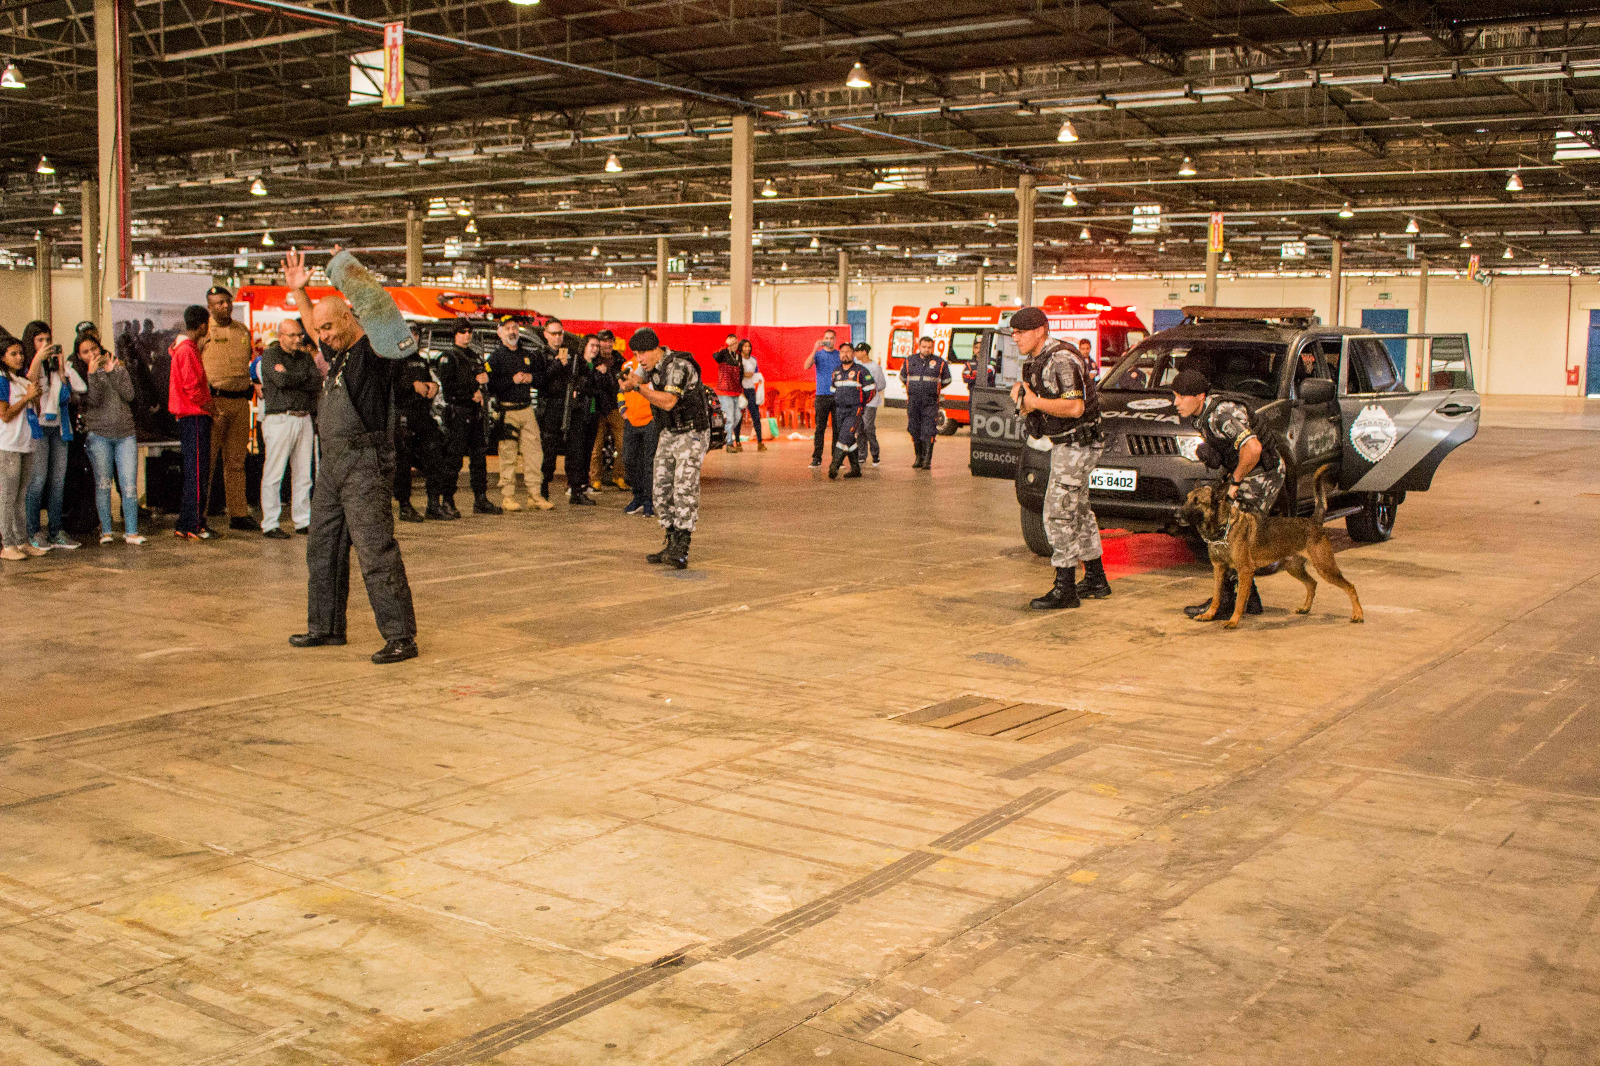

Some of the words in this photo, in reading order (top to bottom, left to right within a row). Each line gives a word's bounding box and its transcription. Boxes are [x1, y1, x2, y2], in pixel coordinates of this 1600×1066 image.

[386, 25, 403, 46] H
[933, 328, 951, 339] SAM
[1101, 411, 1180, 425] OLICIA
[1090, 474, 1134, 488] WS-8402
